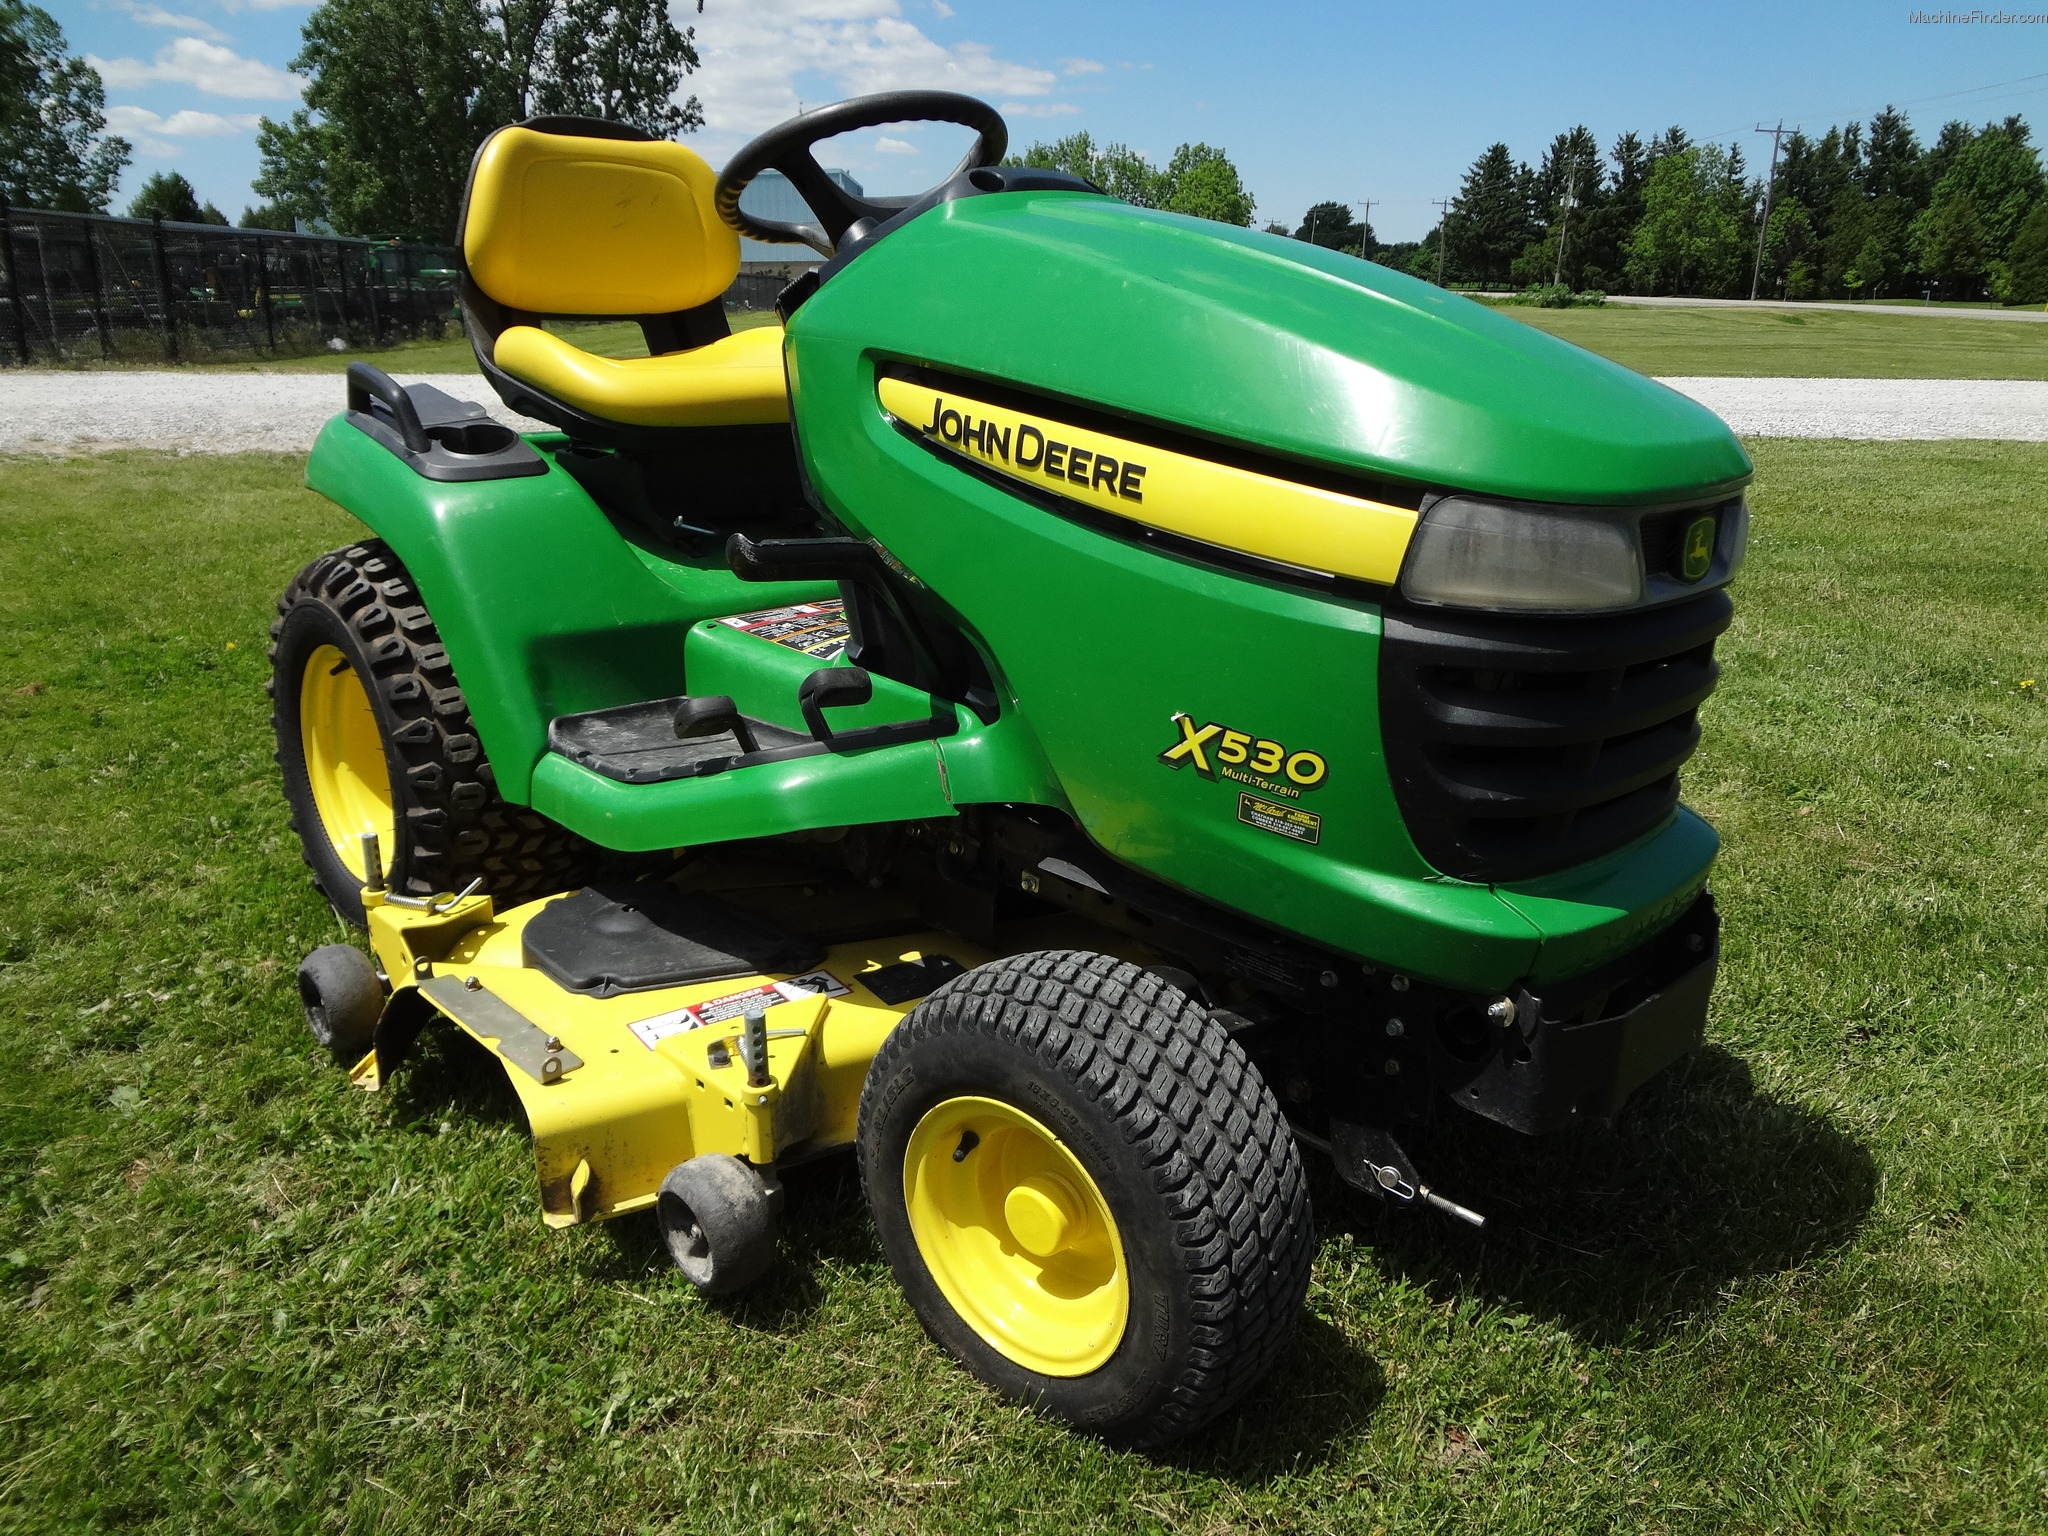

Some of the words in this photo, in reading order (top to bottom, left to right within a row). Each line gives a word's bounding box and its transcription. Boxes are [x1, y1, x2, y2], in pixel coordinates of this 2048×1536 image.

[922, 397, 1012, 461] JOHN
[1015, 423, 1147, 501] DEERE
[1160, 713, 1327, 786] X530
[1221, 766, 1300, 798] Multi-Terrain
[713, 988, 764, 1006] DANGER
[1153, 1294, 1170, 1362] TURF
